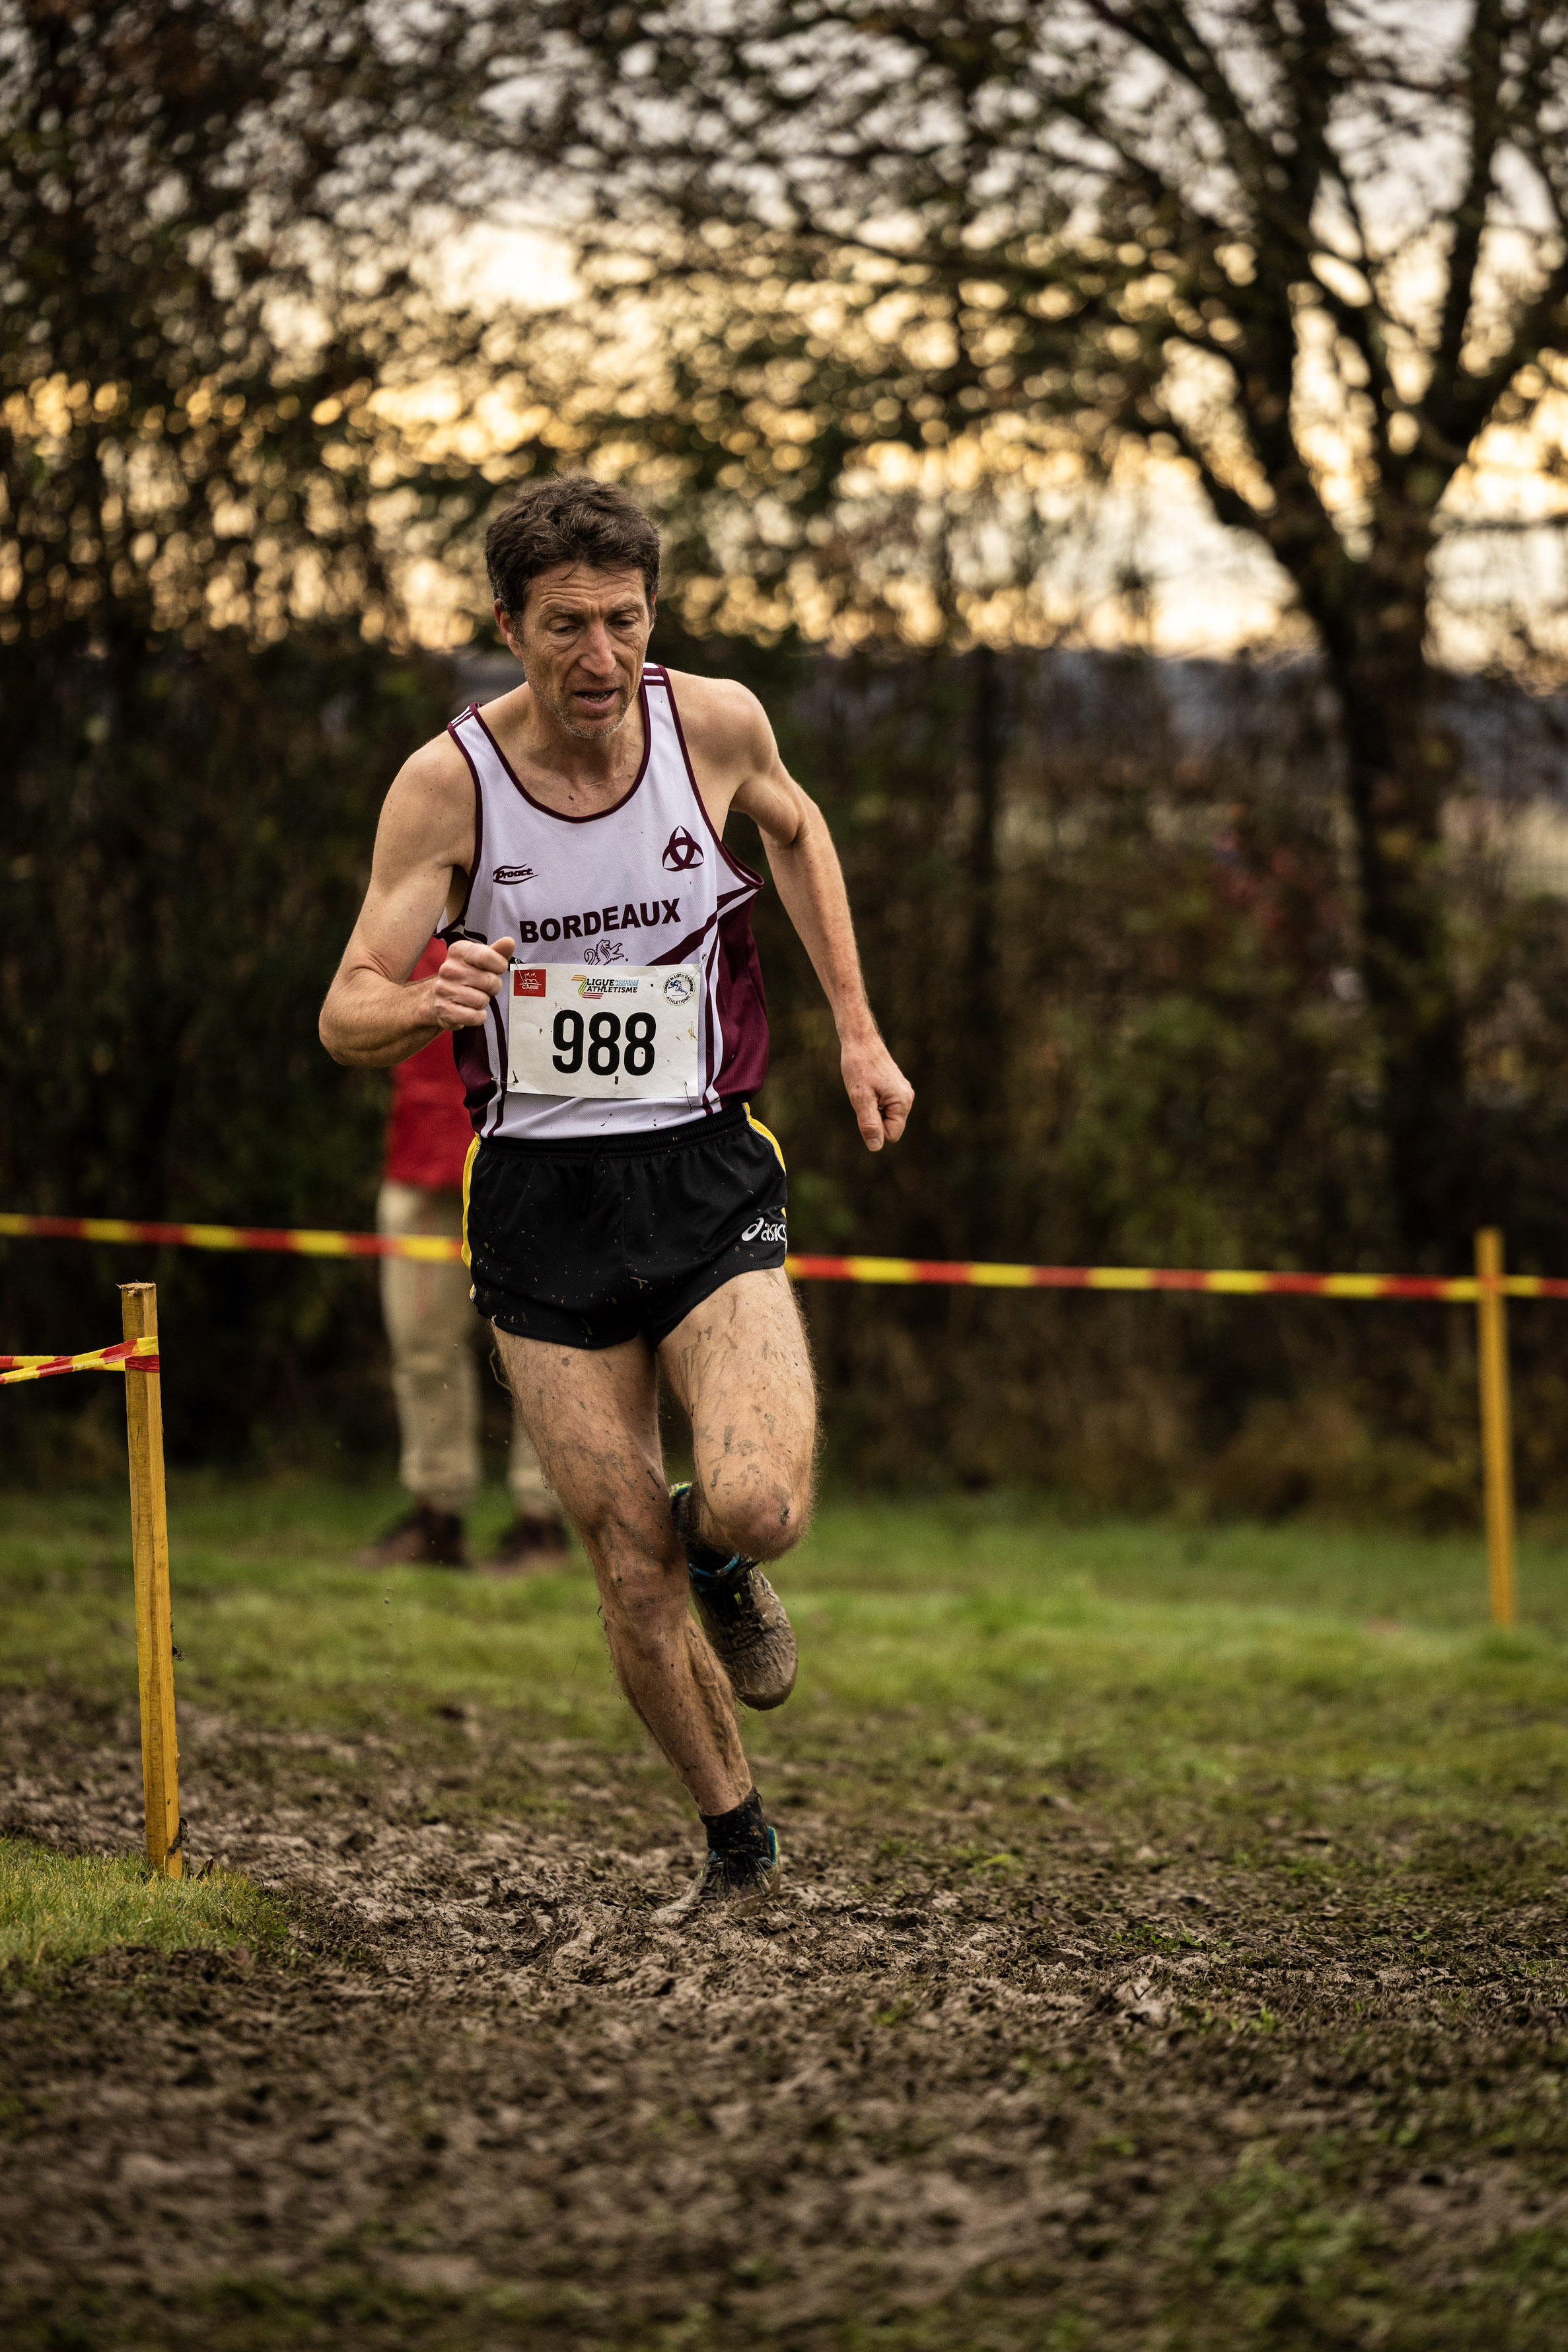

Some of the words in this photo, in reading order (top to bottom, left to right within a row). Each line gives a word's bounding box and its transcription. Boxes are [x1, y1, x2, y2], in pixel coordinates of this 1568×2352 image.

[519, 898, 682, 943] BORDEAUX
[666, 995, 691, 1005] ATHLETISME
[552, 1009, 657, 1077] 988
